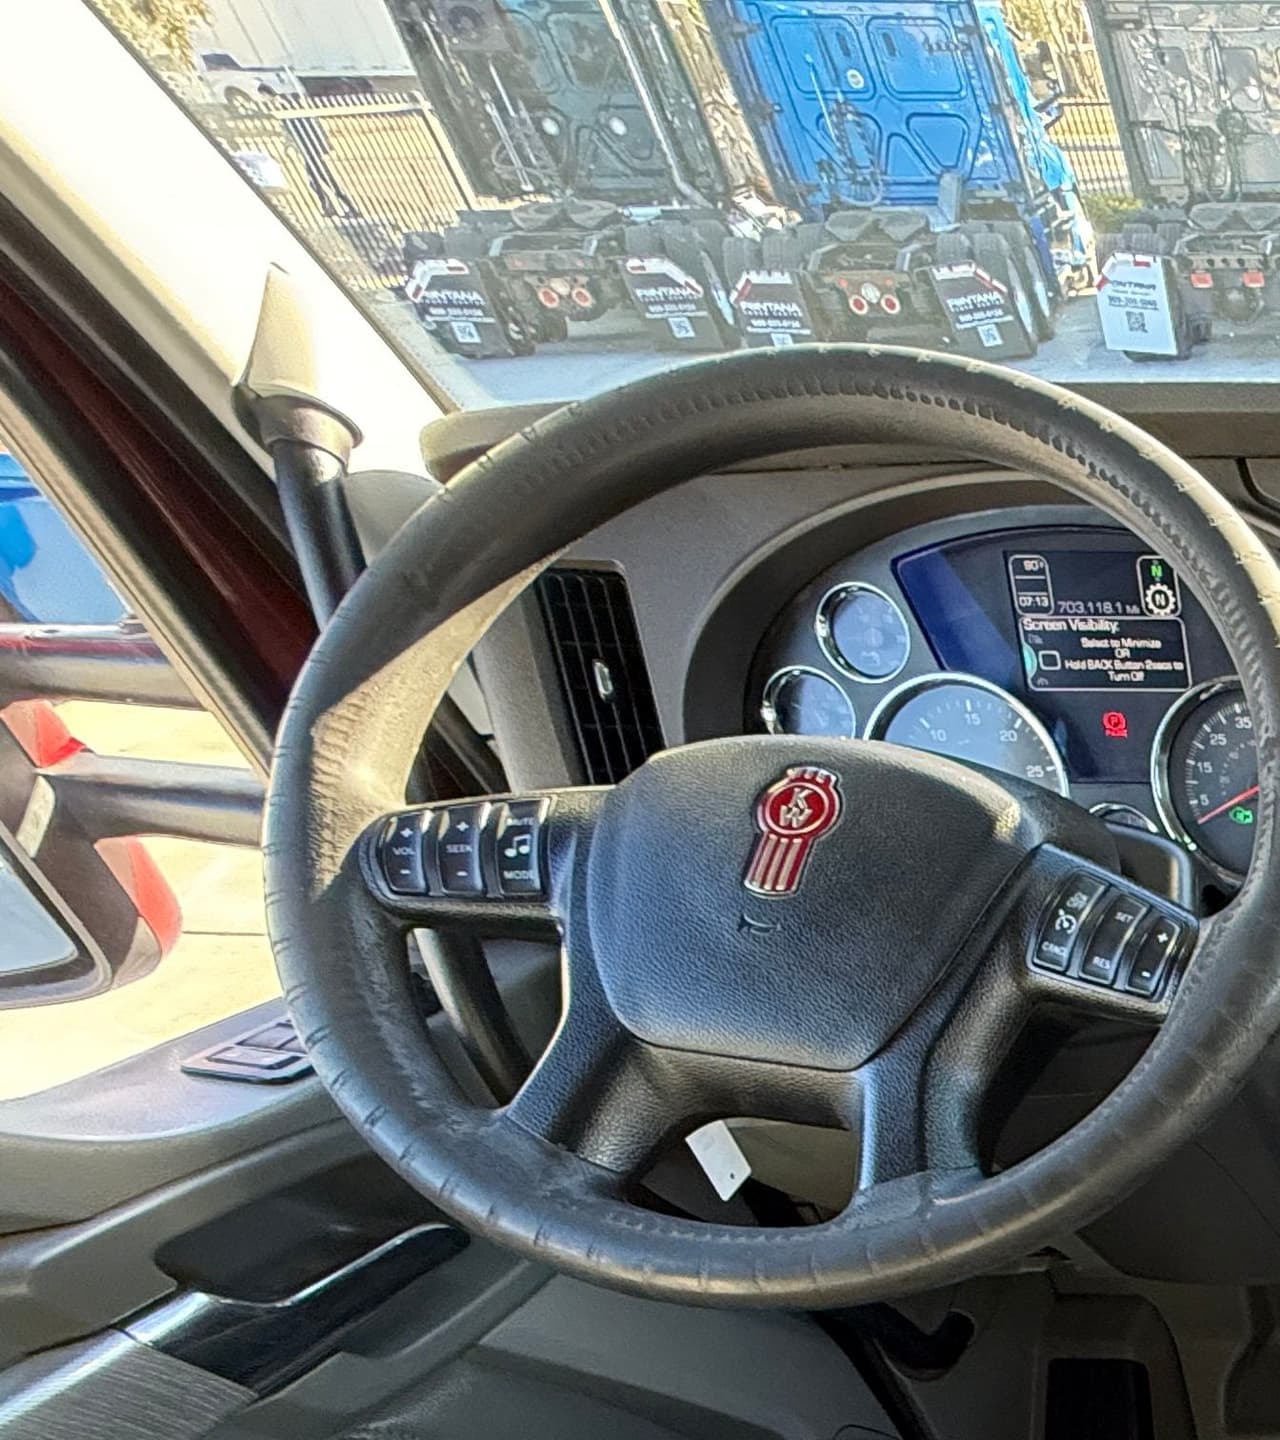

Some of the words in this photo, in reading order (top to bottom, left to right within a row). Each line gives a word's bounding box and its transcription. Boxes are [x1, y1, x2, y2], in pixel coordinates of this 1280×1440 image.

[1151, 565, 1162, 577] N
[1019, 596, 1049, 607] 07:13
[1154, 593, 1166, 607] N
[1022, 618, 1067, 631] Screen
[1080, 637, 1108, 649] Select
[1110, 639, 1121, 648] to
[1122, 638, 1162, 649] Minimize
[1114, 649, 1130, 658] OR
[1065, 660, 1086, 669] Hold
[1088, 660, 1112, 670] BACK
[1114, 660, 1144, 670] Button
[1174, 662, 1184, 670] to
[1108, 671, 1130, 681] Turn
[1131, 671, 1144, 681] Off
[964, 713, 981, 726] 15
[1235, 717, 1252, 729] 35
[930, 729, 947, 741] 10
[1000, 730, 1018, 742] 20
[1209, 733, 1227, 746] 25
[1025, 765, 1044, 778] 25
[1197, 762, 1212, 773] 15
[1199, 794, 1209, 806] 5
[393, 847, 417, 855] VOL
[446, 844, 473, 853] SEEK
[503, 869, 536, 880] MODE
[1113, 911, 1134, 924] SET
[1091, 956, 1111, 969] RES
